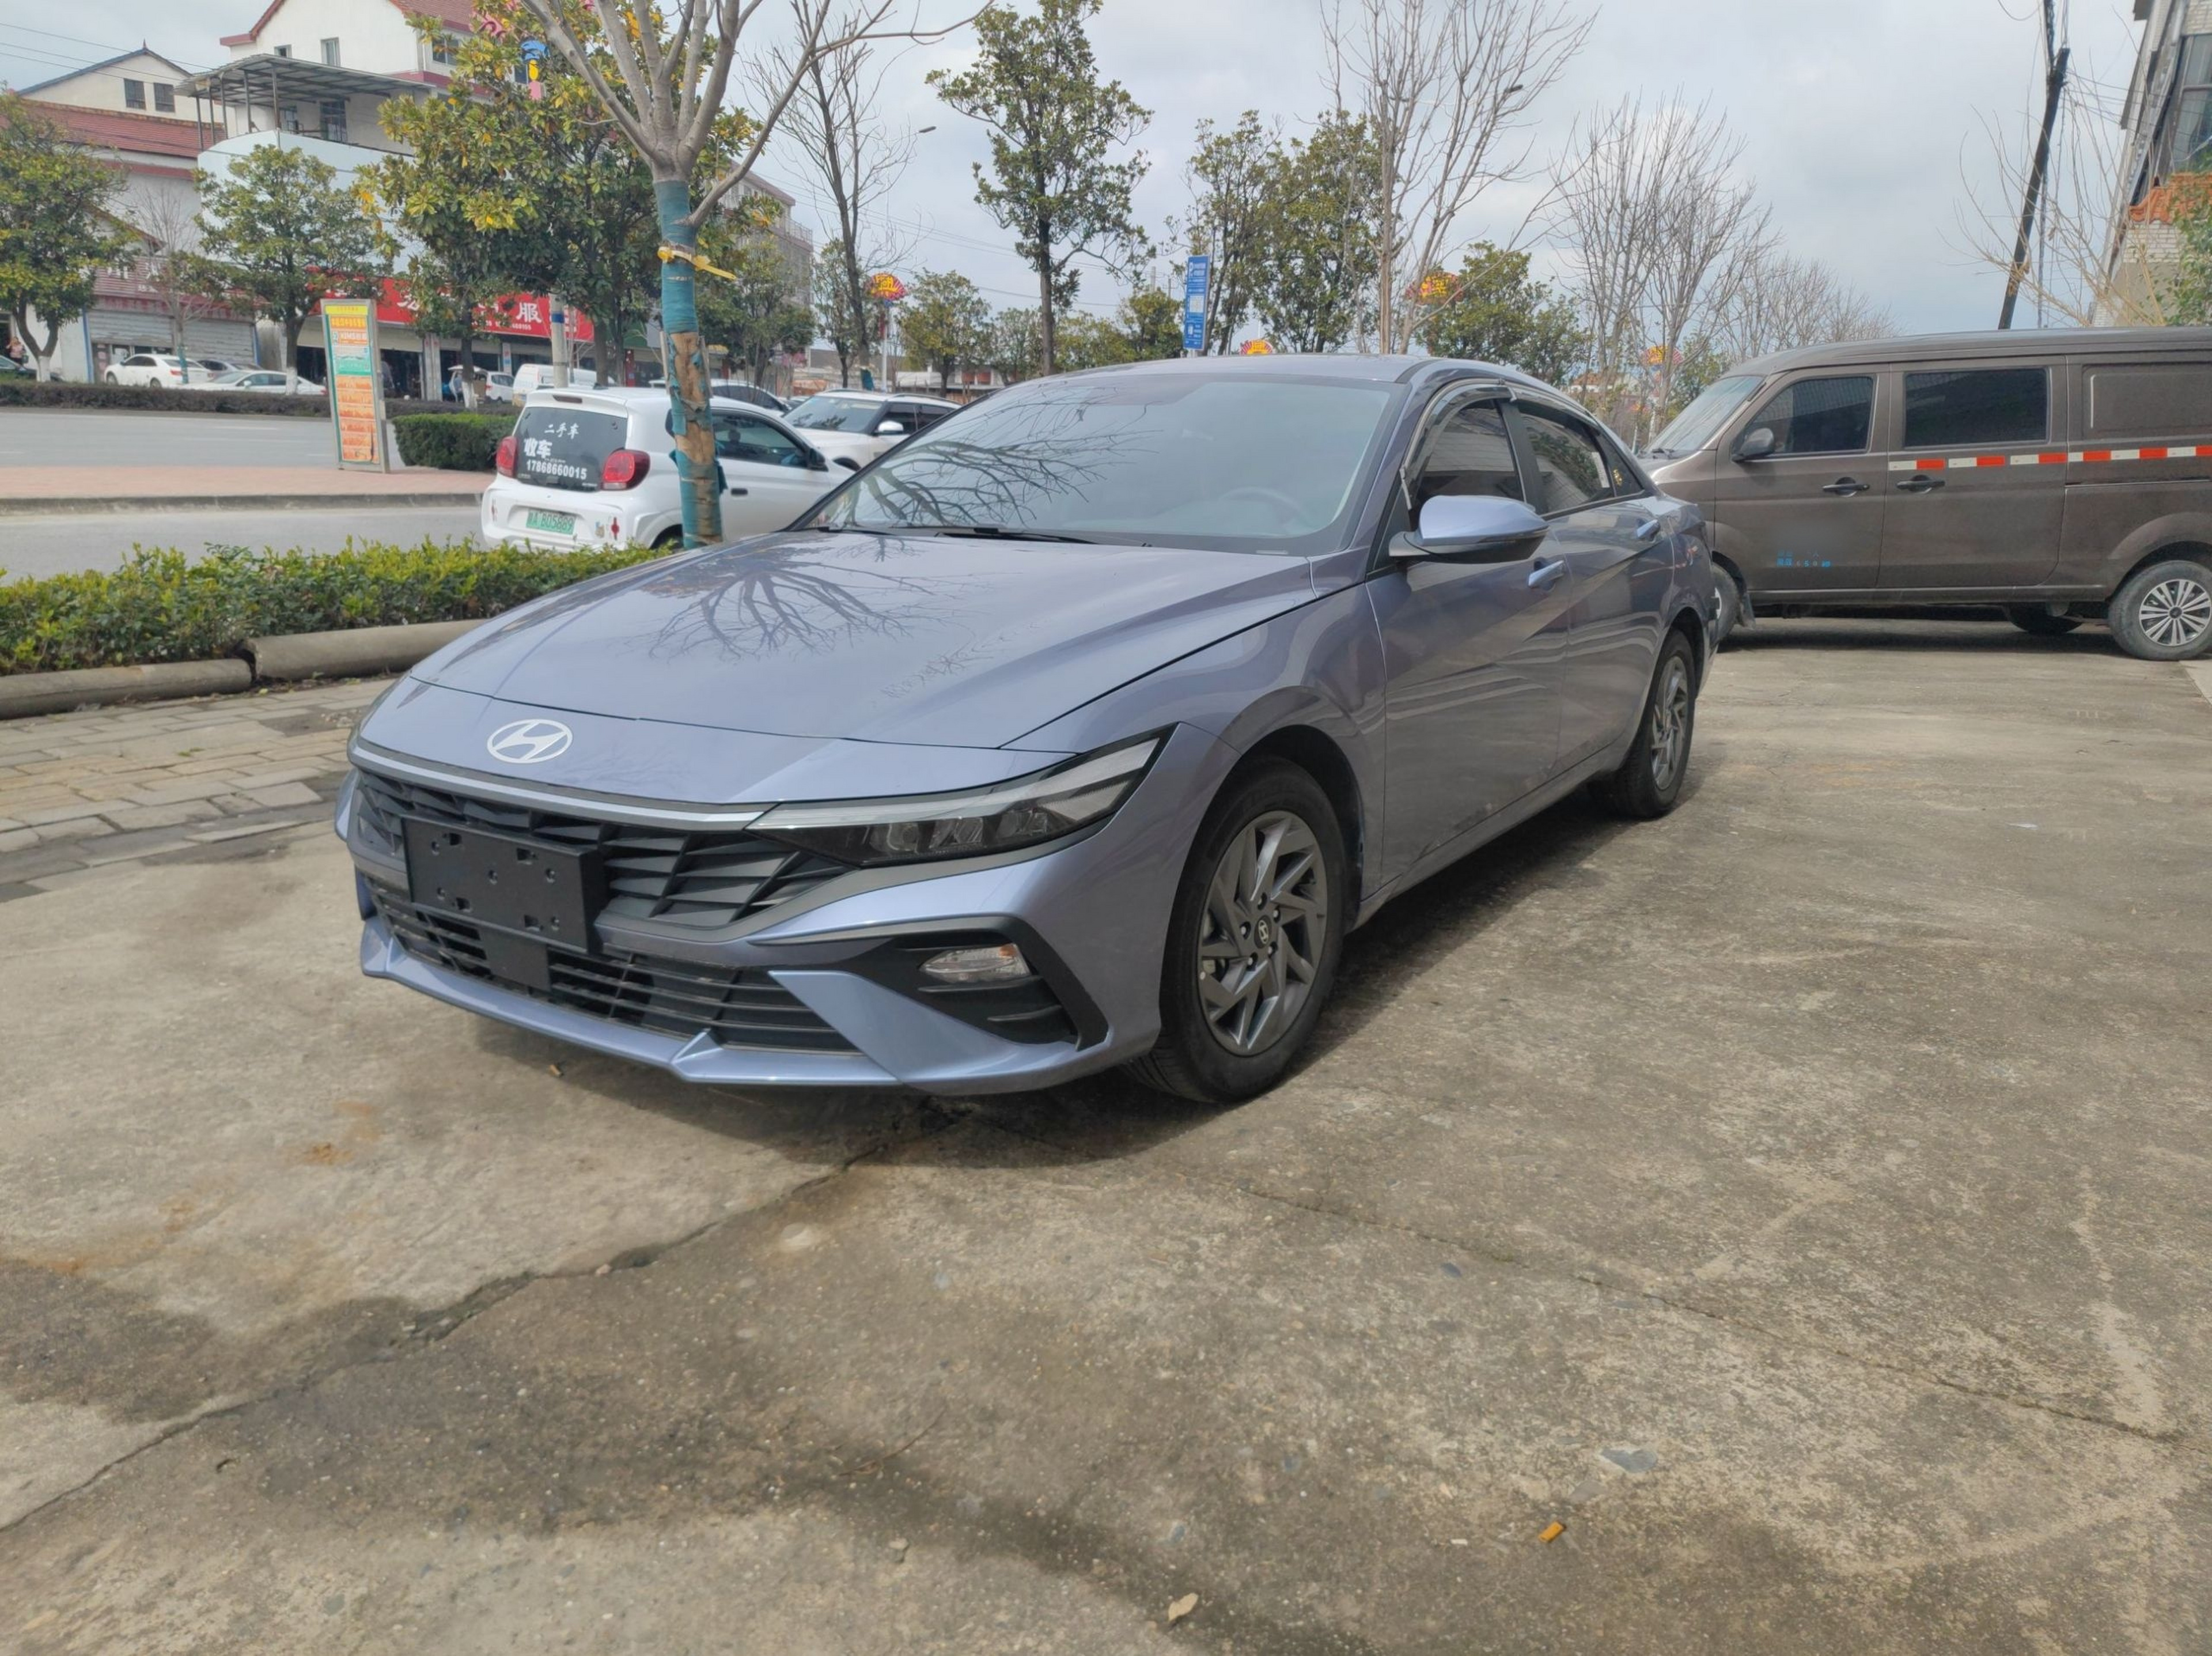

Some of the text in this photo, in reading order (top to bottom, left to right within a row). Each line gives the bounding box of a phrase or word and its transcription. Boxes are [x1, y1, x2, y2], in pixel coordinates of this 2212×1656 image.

[544, 422, 579, 439] 二手车
[524, 438, 552, 459] 收车
[526, 459, 588, 480] 17868660015
